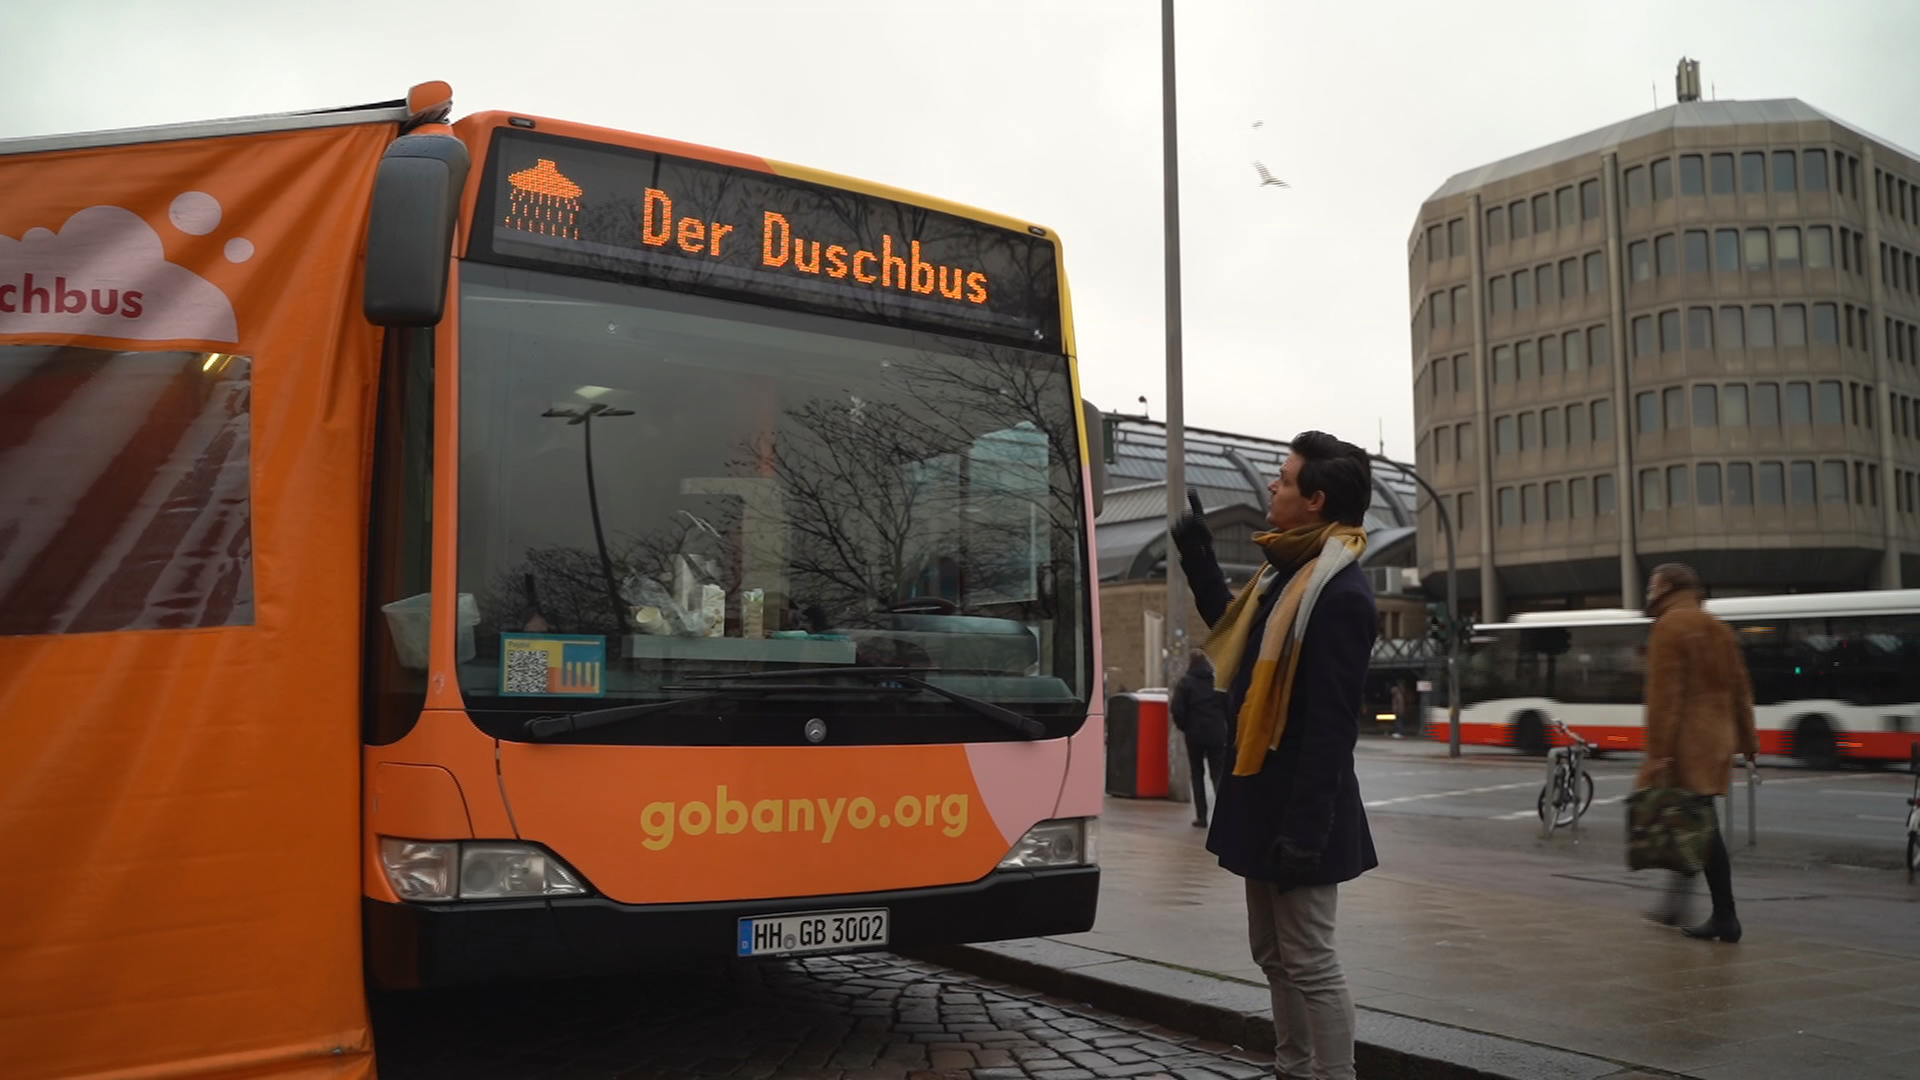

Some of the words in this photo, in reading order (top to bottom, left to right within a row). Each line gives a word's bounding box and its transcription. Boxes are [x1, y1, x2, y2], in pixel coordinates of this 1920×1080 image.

[643, 187, 733, 256] Der
[762, 211, 988, 304] Duschbus
[640, 785, 968, 851] gobanyo.org
[754, 922, 782, 950] HH
[800, 919, 826, 946] GB
[832, 915, 883, 943] 3002
